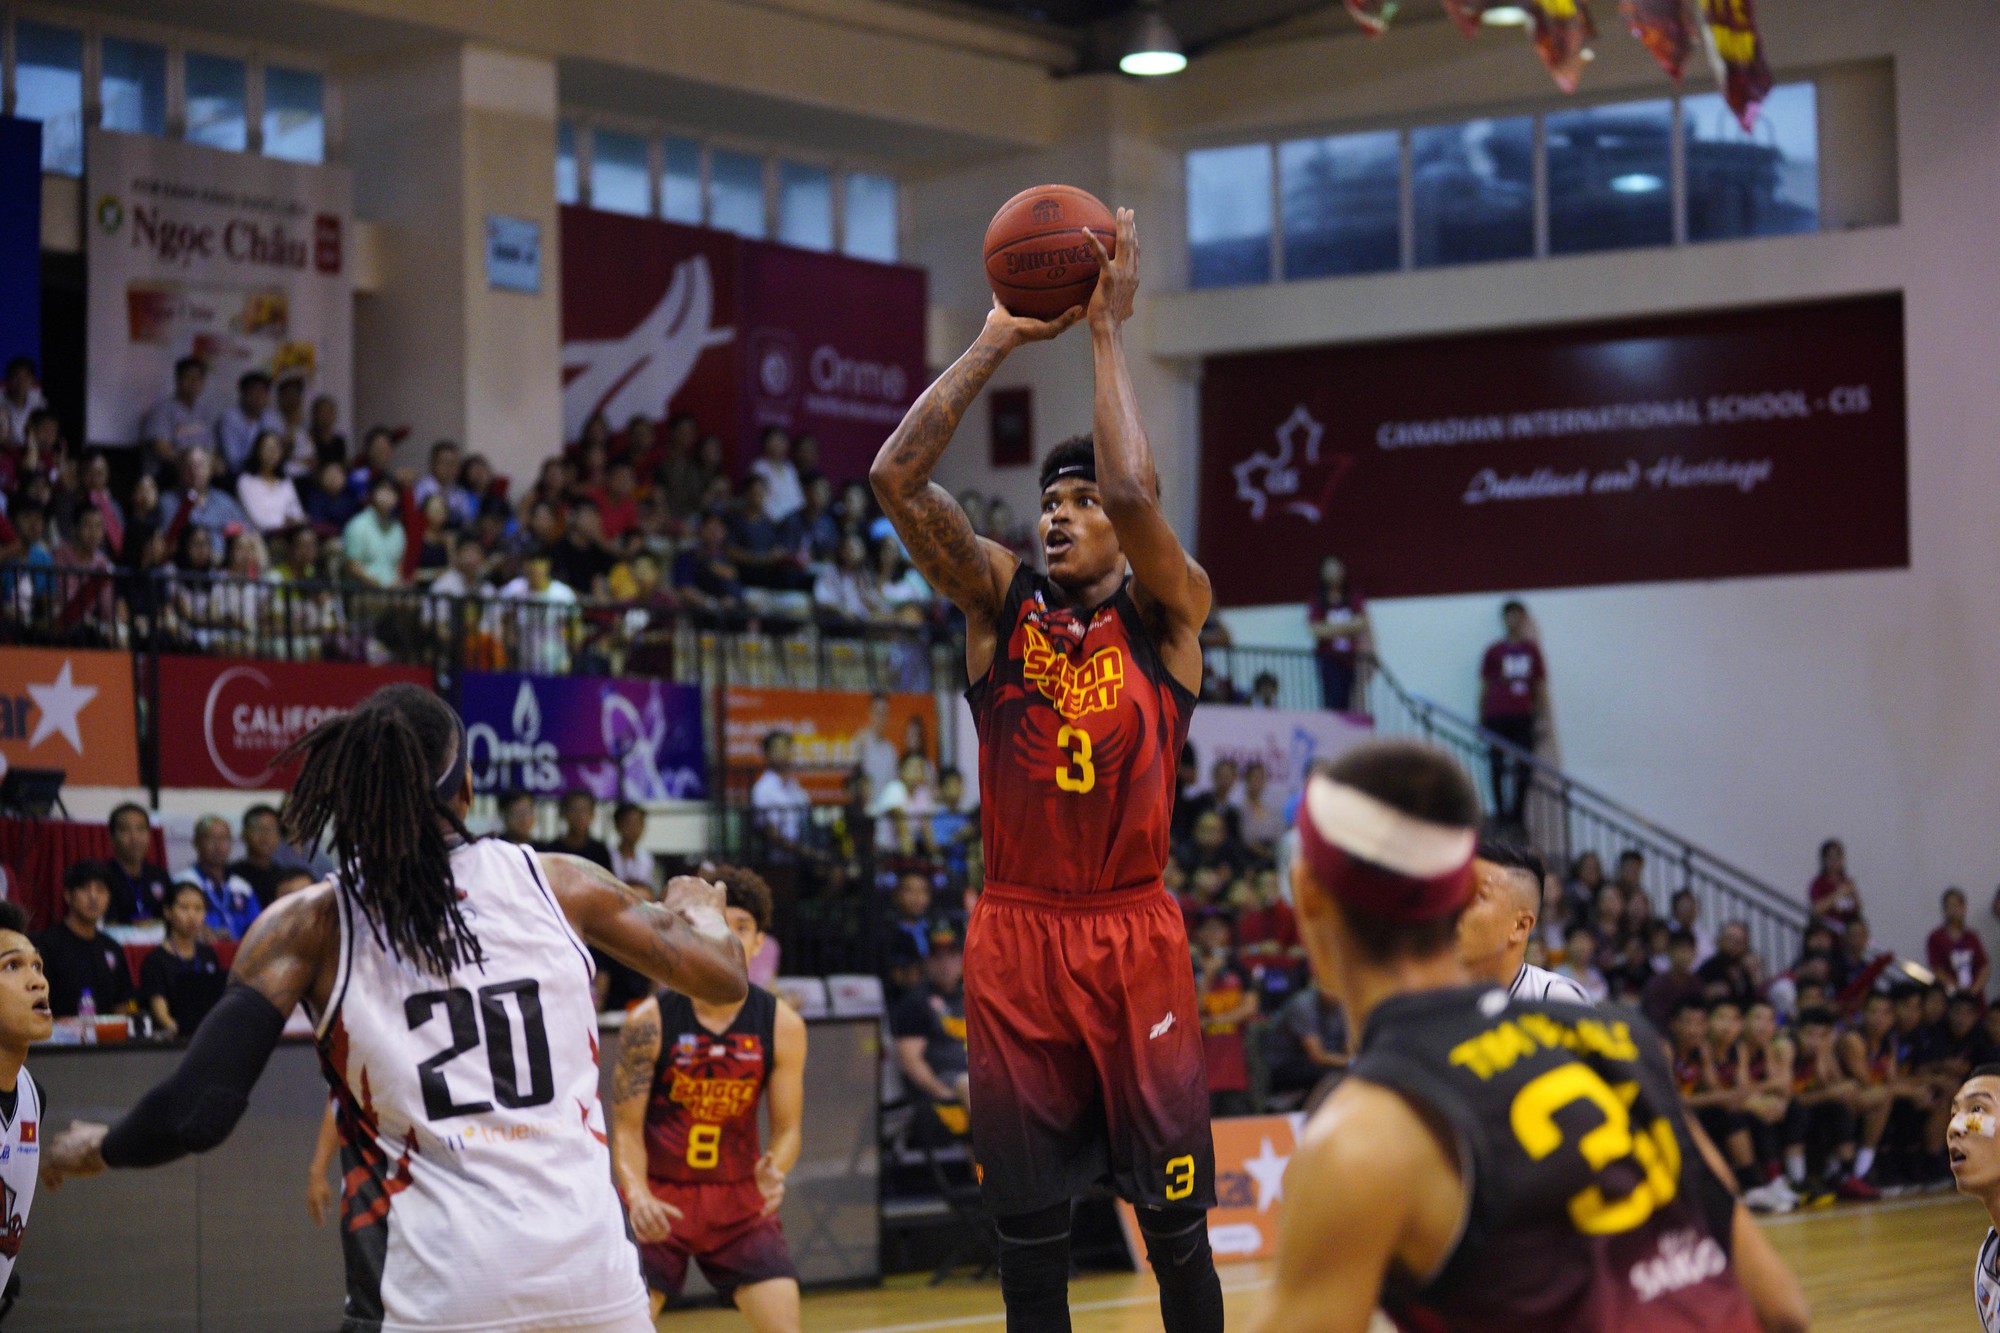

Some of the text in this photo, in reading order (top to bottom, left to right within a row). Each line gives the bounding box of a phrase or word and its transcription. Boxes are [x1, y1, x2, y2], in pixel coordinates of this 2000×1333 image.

[1376, 419, 1501, 450] CANADIAN
[1508, 400, 1699, 440] INTERNATIONAL
[1706, 391, 1809, 424] SCHOOL
[1828, 385, 1871, 415] CIS
[1056, 725, 1095, 794] 3
[404, 978, 555, 1121] 20
[686, 1124, 721, 1169] 8
[1166, 1154, 1195, 1201] 3
